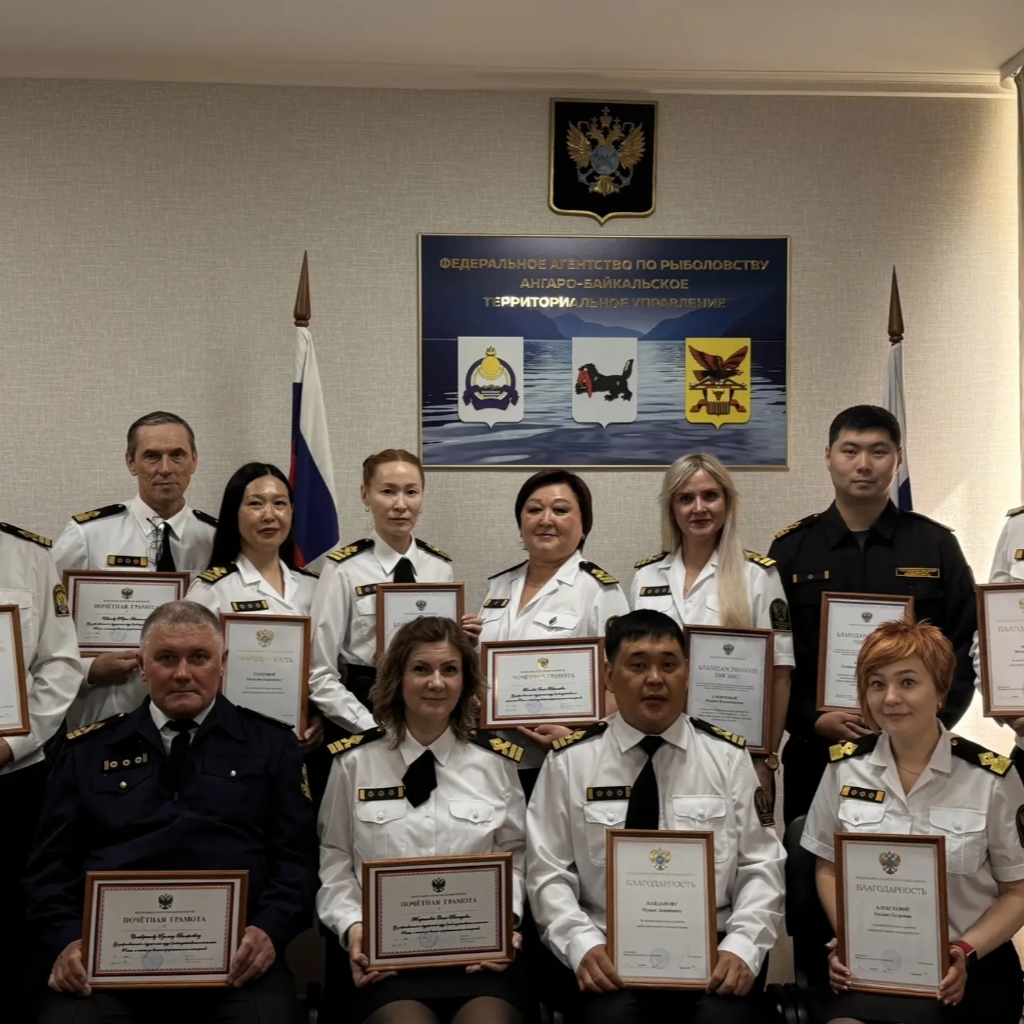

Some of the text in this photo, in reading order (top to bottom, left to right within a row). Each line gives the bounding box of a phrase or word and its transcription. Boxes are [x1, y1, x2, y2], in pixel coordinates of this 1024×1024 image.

[439, 257, 769, 271] ФЕДЕРАЛЬНОЕ АГЕНТСТВО ПО РЫБОЛОВСТВУ
[520, 276, 689, 290] АНГАРО-БАЙКАЛЬСКОЕ
[483, 296, 726, 309] ТЕРРИТОРИАЛЬНОЕ УПРАВЛЕНИЕ
[626, 879, 697, 888] БЛАГОДАРНОСТЬ
[856, 884, 928, 896] БЛАГОДАРНОСТЬ
[401, 897, 477, 908] ПОЧЁТНАЯ ГРАМОТА
[123, 915, 206, 924] ПОЧЁТНАЯ ГРАМОТА
